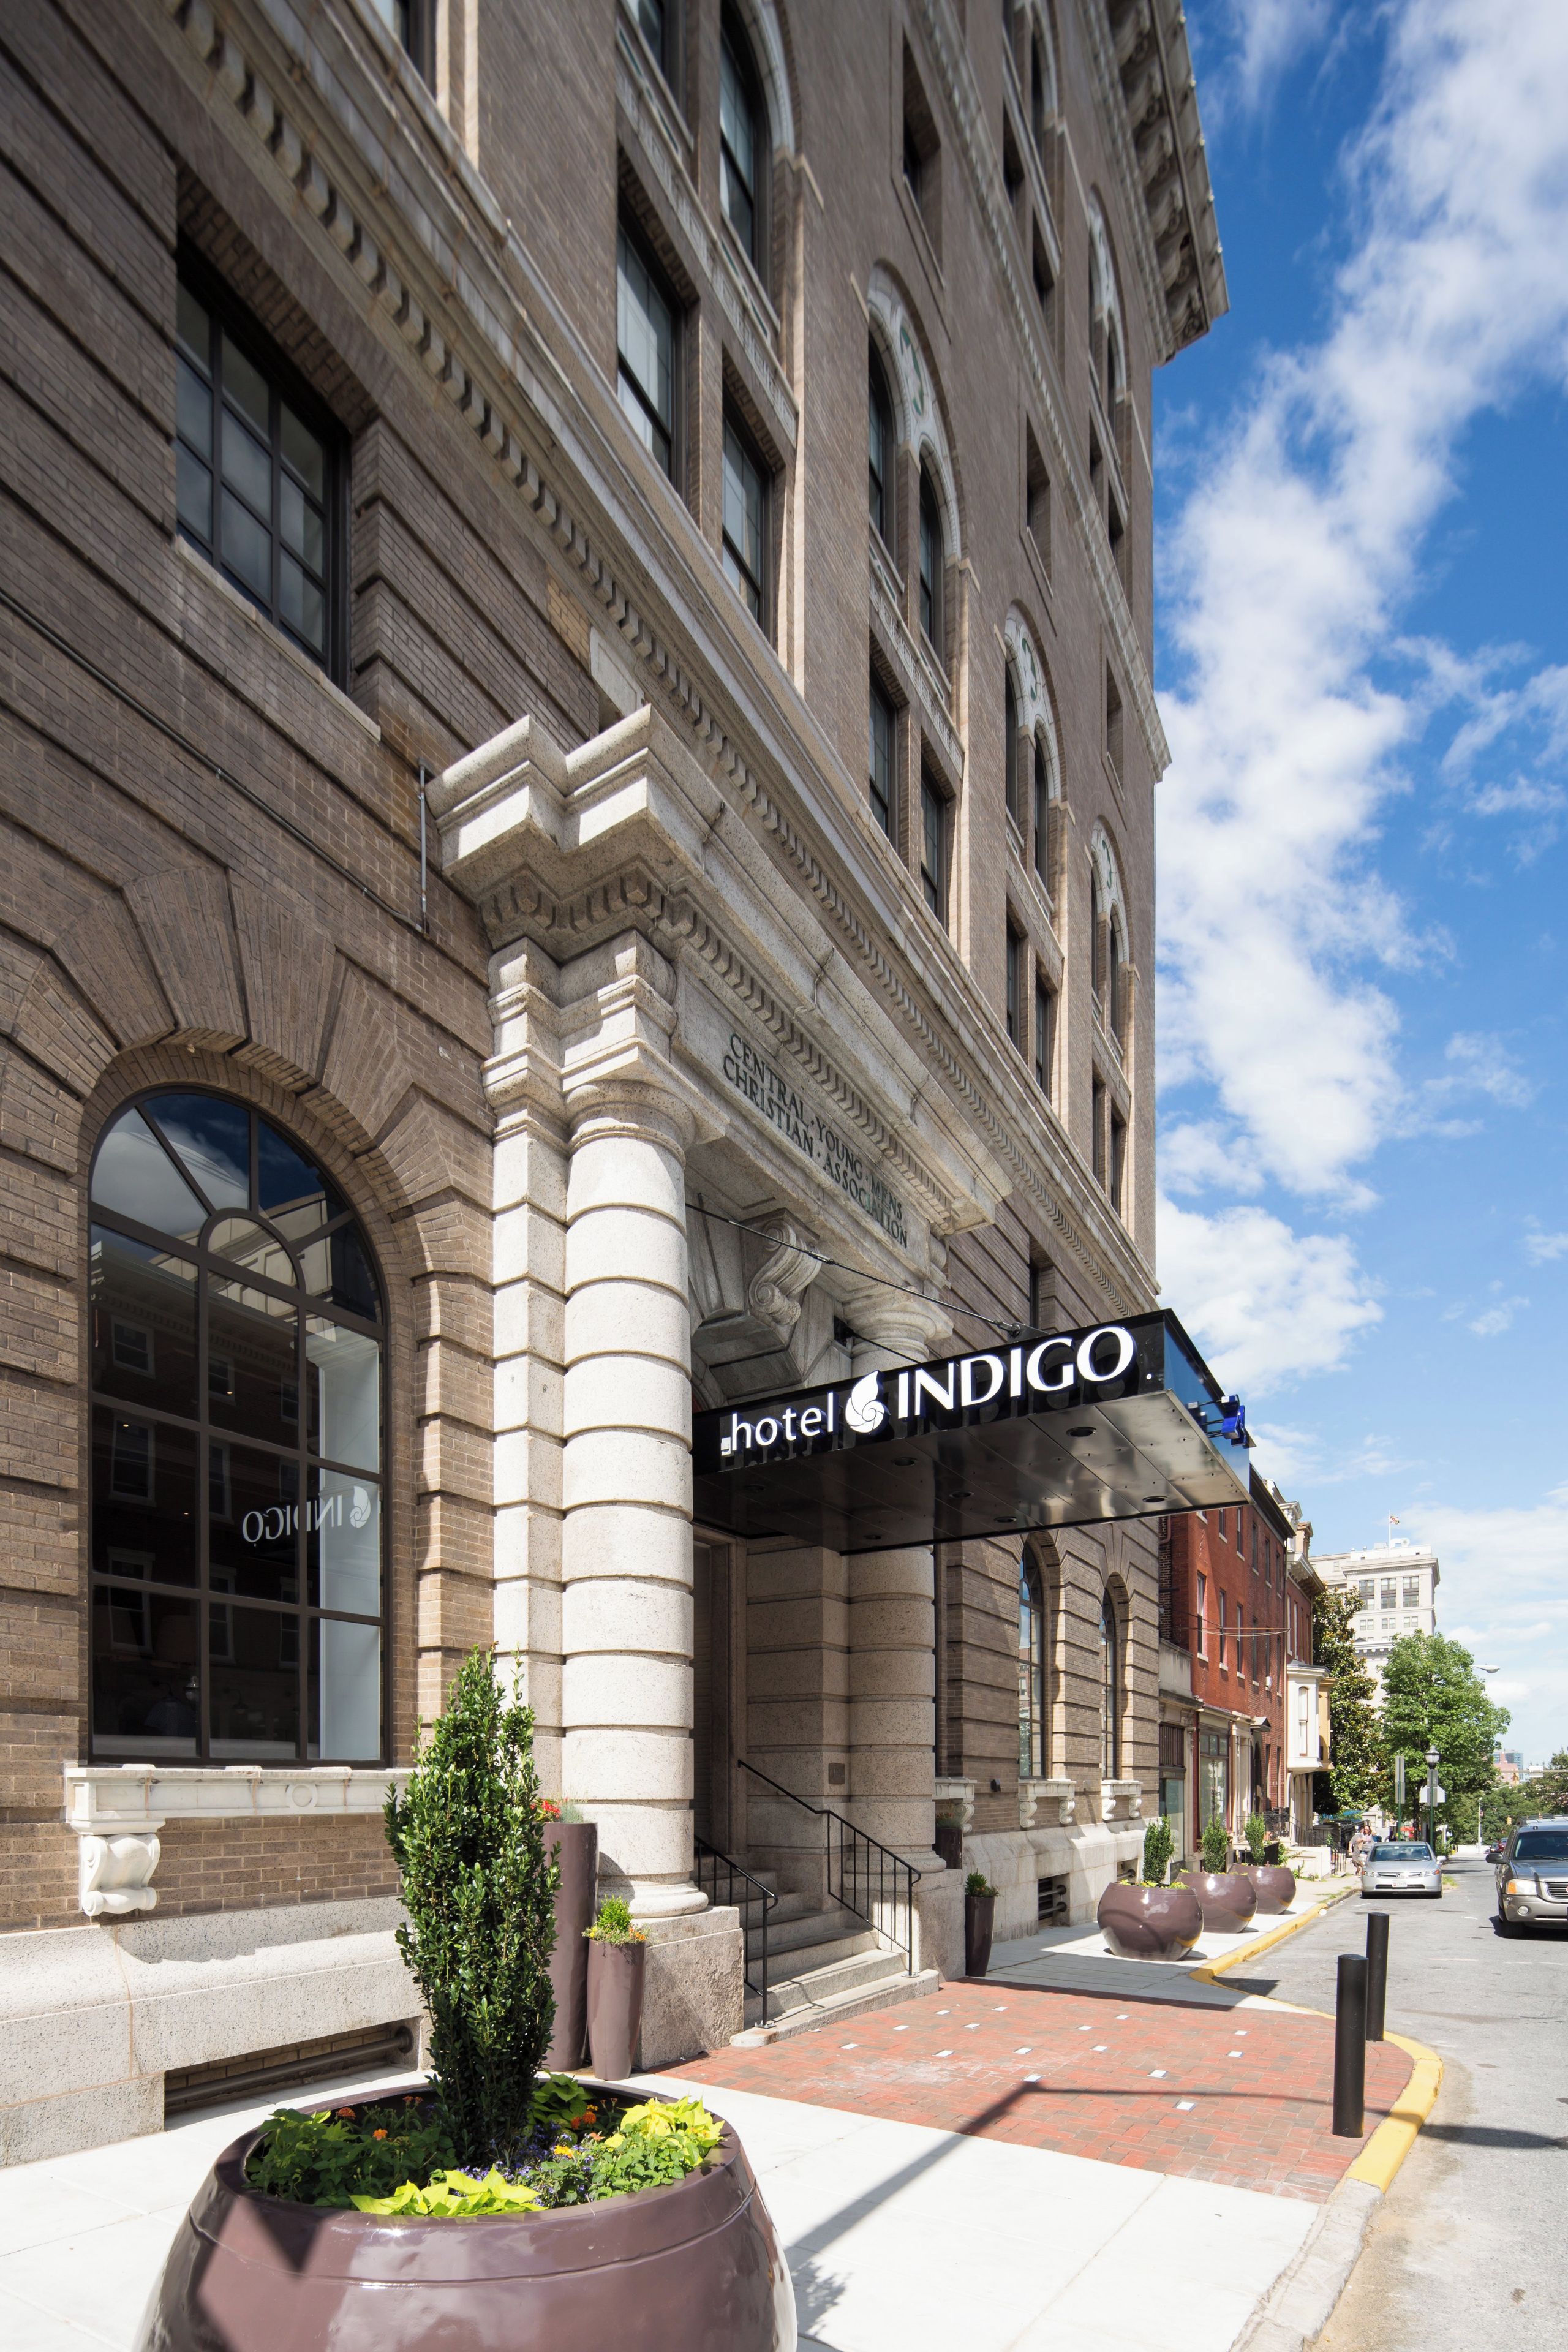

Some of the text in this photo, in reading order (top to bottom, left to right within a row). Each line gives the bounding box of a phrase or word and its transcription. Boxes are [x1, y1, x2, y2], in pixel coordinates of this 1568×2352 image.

[723, 1055, 908, 1249] CHRISTIAN ASSOCIATION
[730, 1033, 902, 1221] CENTRAL YOUNG MENS
[731, 1325, 1134, 1451] hotel INDIGO
